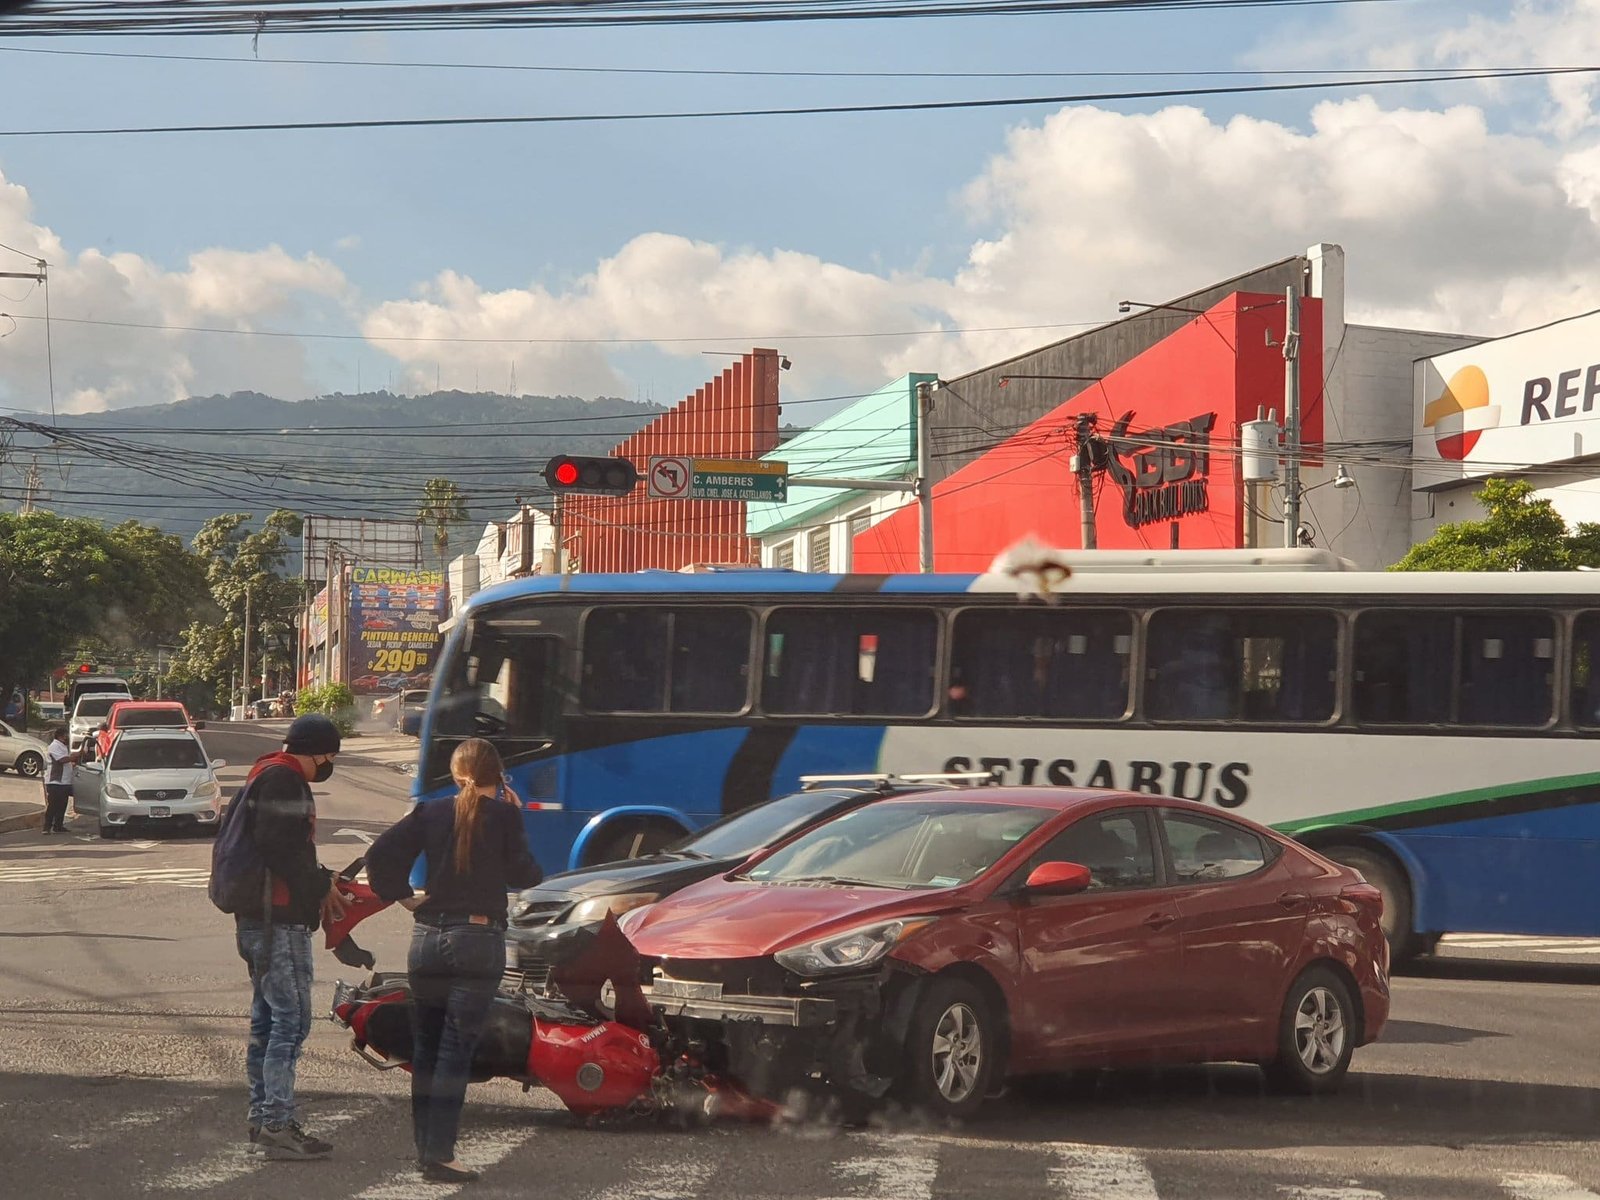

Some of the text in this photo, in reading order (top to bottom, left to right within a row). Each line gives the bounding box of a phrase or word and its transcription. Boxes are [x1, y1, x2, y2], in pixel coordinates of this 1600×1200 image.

[693, 475, 754, 487] C. AMBERES
[352, 568, 443, 585] CARWASH
[361, 631, 439, 643] PINTURA GENERAL
[581, 1024, 607, 1043] YAMAHA
